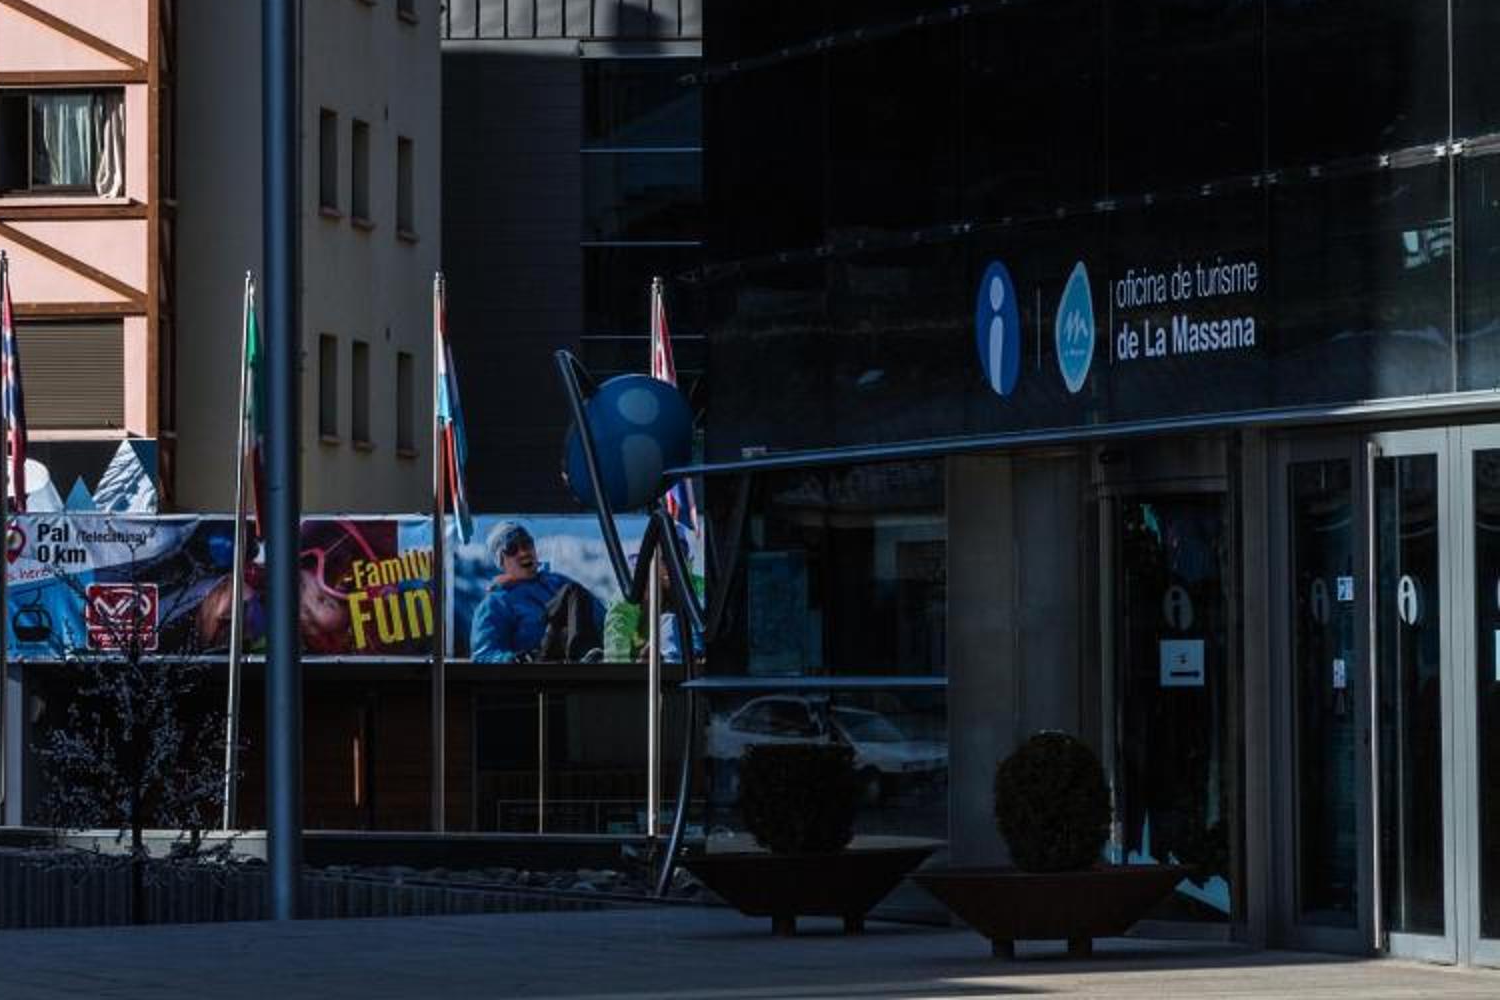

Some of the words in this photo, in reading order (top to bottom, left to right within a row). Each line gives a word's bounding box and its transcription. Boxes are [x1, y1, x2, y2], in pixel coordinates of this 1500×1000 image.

[1115, 269, 1166, 308] oficina
[1171, 264, 1191, 300] de
[1197, 257, 1258, 297] turisme
[1117, 324, 1139, 361] de
[1144, 320, 1167, 358] La
[1171, 314, 1256, 354] Massana
[37, 523, 69, 543] Pal
[37, 546, 51, 563] 0
[55, 545, 86, 563] km
[347, 588, 435, 650] Fun
